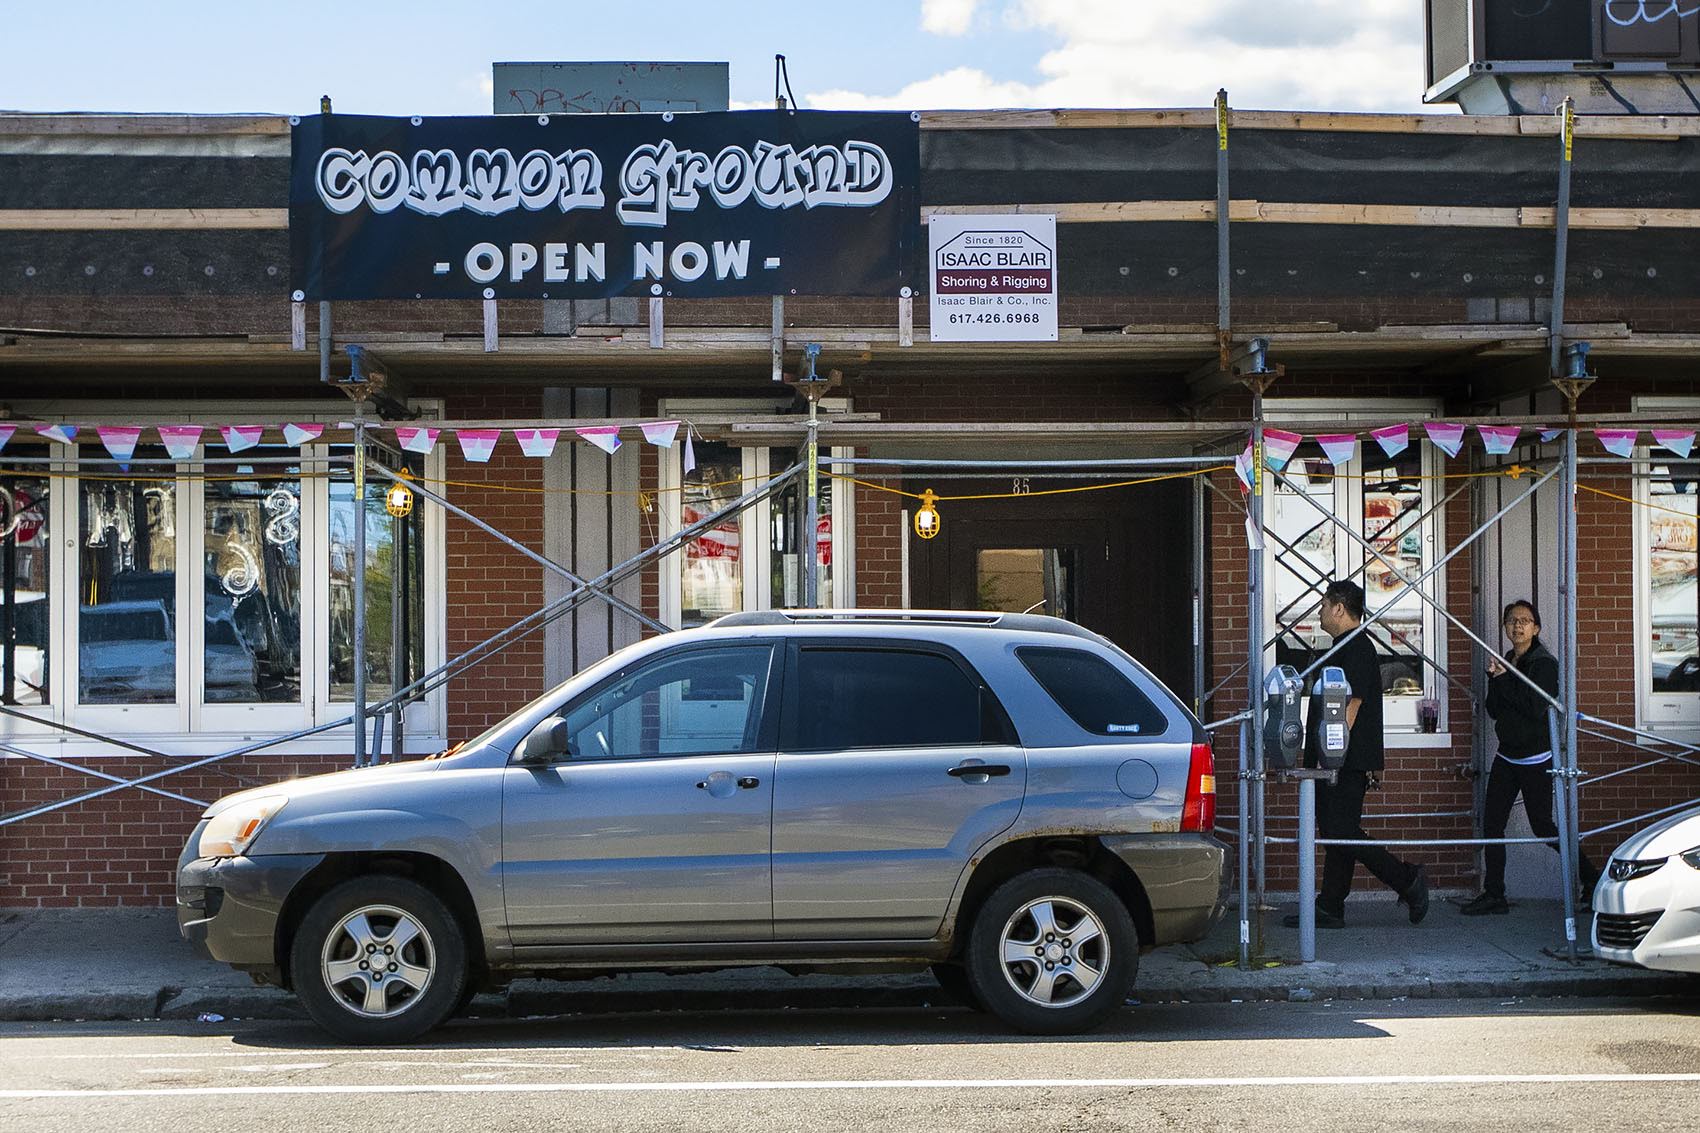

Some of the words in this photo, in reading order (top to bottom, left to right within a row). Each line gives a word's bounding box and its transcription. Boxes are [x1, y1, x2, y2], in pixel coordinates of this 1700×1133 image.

[965, 236, 994, 245] Since
[999, 236, 1023, 245] 1820
[464, 242, 606, 283] OPEN
[634, 240, 751, 280] NOW
[941, 252, 992, 267] ISAAC
[997, 252, 1047, 266] BLAIR
[941, 275, 987, 289] Shoring
[990, 275, 999, 287] &
[1002, 275, 1047, 289] Rigging
[938, 297, 966, 306] Isaac
[969, 296, 994, 306] Blair
[996, 296, 1004, 305] &
[1007, 296, 1029, 307] Co.,
[1032, 296, 1051, 305] Inc.
[949, 313, 1040, 324] 617.426.6968
[1013, 477, 1030, 495] 85
